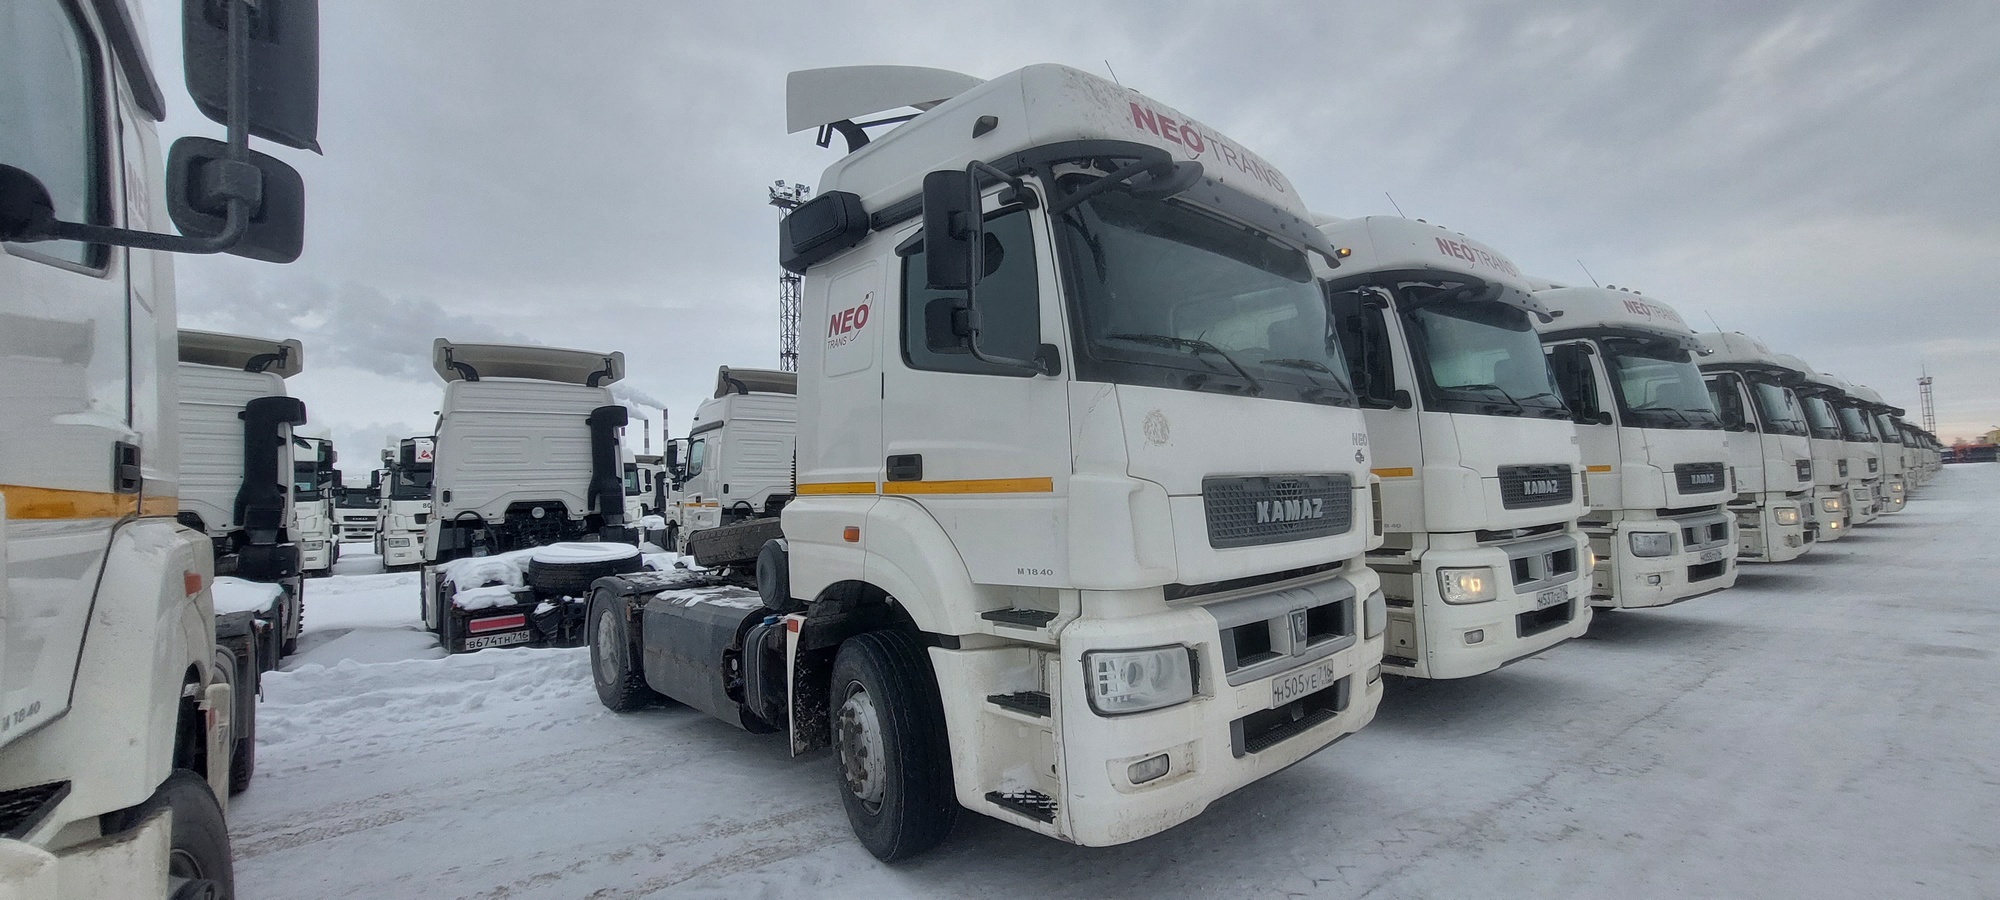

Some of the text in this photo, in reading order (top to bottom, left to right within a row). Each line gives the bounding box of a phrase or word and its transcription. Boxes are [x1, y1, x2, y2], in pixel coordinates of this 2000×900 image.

[1129, 102, 1284, 193] NEO TRANS
[1435, 237, 1475, 262] NEO
[828, 304, 869, 338] NEO
[828, 336, 847, 350] TRANS
[1523, 480, 1559, 496] KAMAZ
[1257, 498, 1323, 524] KAMAZ
